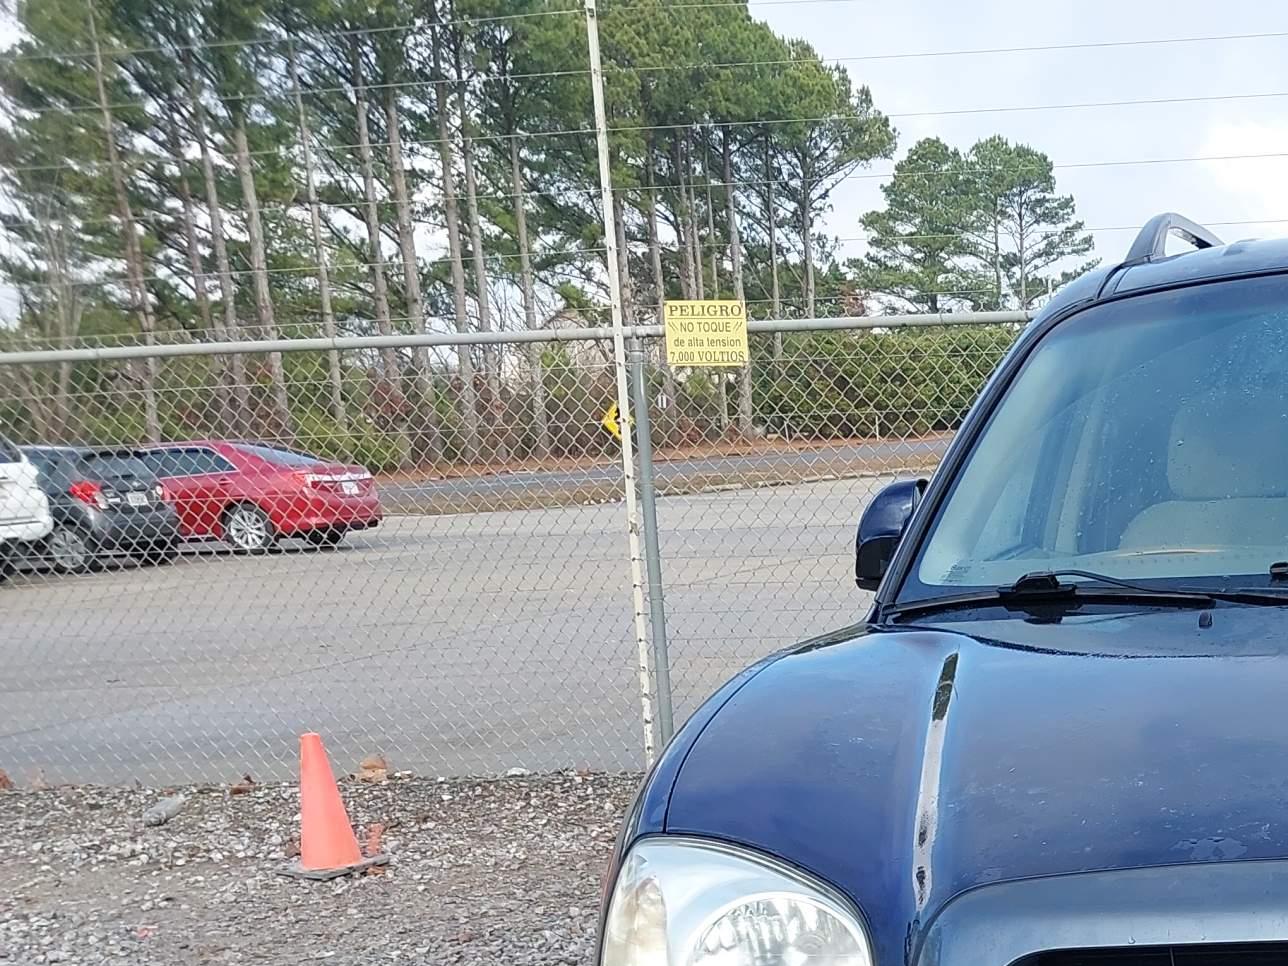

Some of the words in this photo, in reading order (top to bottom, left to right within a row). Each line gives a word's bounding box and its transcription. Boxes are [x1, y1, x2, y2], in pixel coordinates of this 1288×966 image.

[668, 304, 742, 317] PELIGRO
[680, 321, 695, 333] NO
[697, 321, 731, 333] TOQUE
[673, 337, 685, 347] de
[688, 337, 704, 347] alta
[707, 337, 741, 347] tension
[670, 351, 695, 363] 7,000
[698, 350, 744, 362] VOLTIOS
